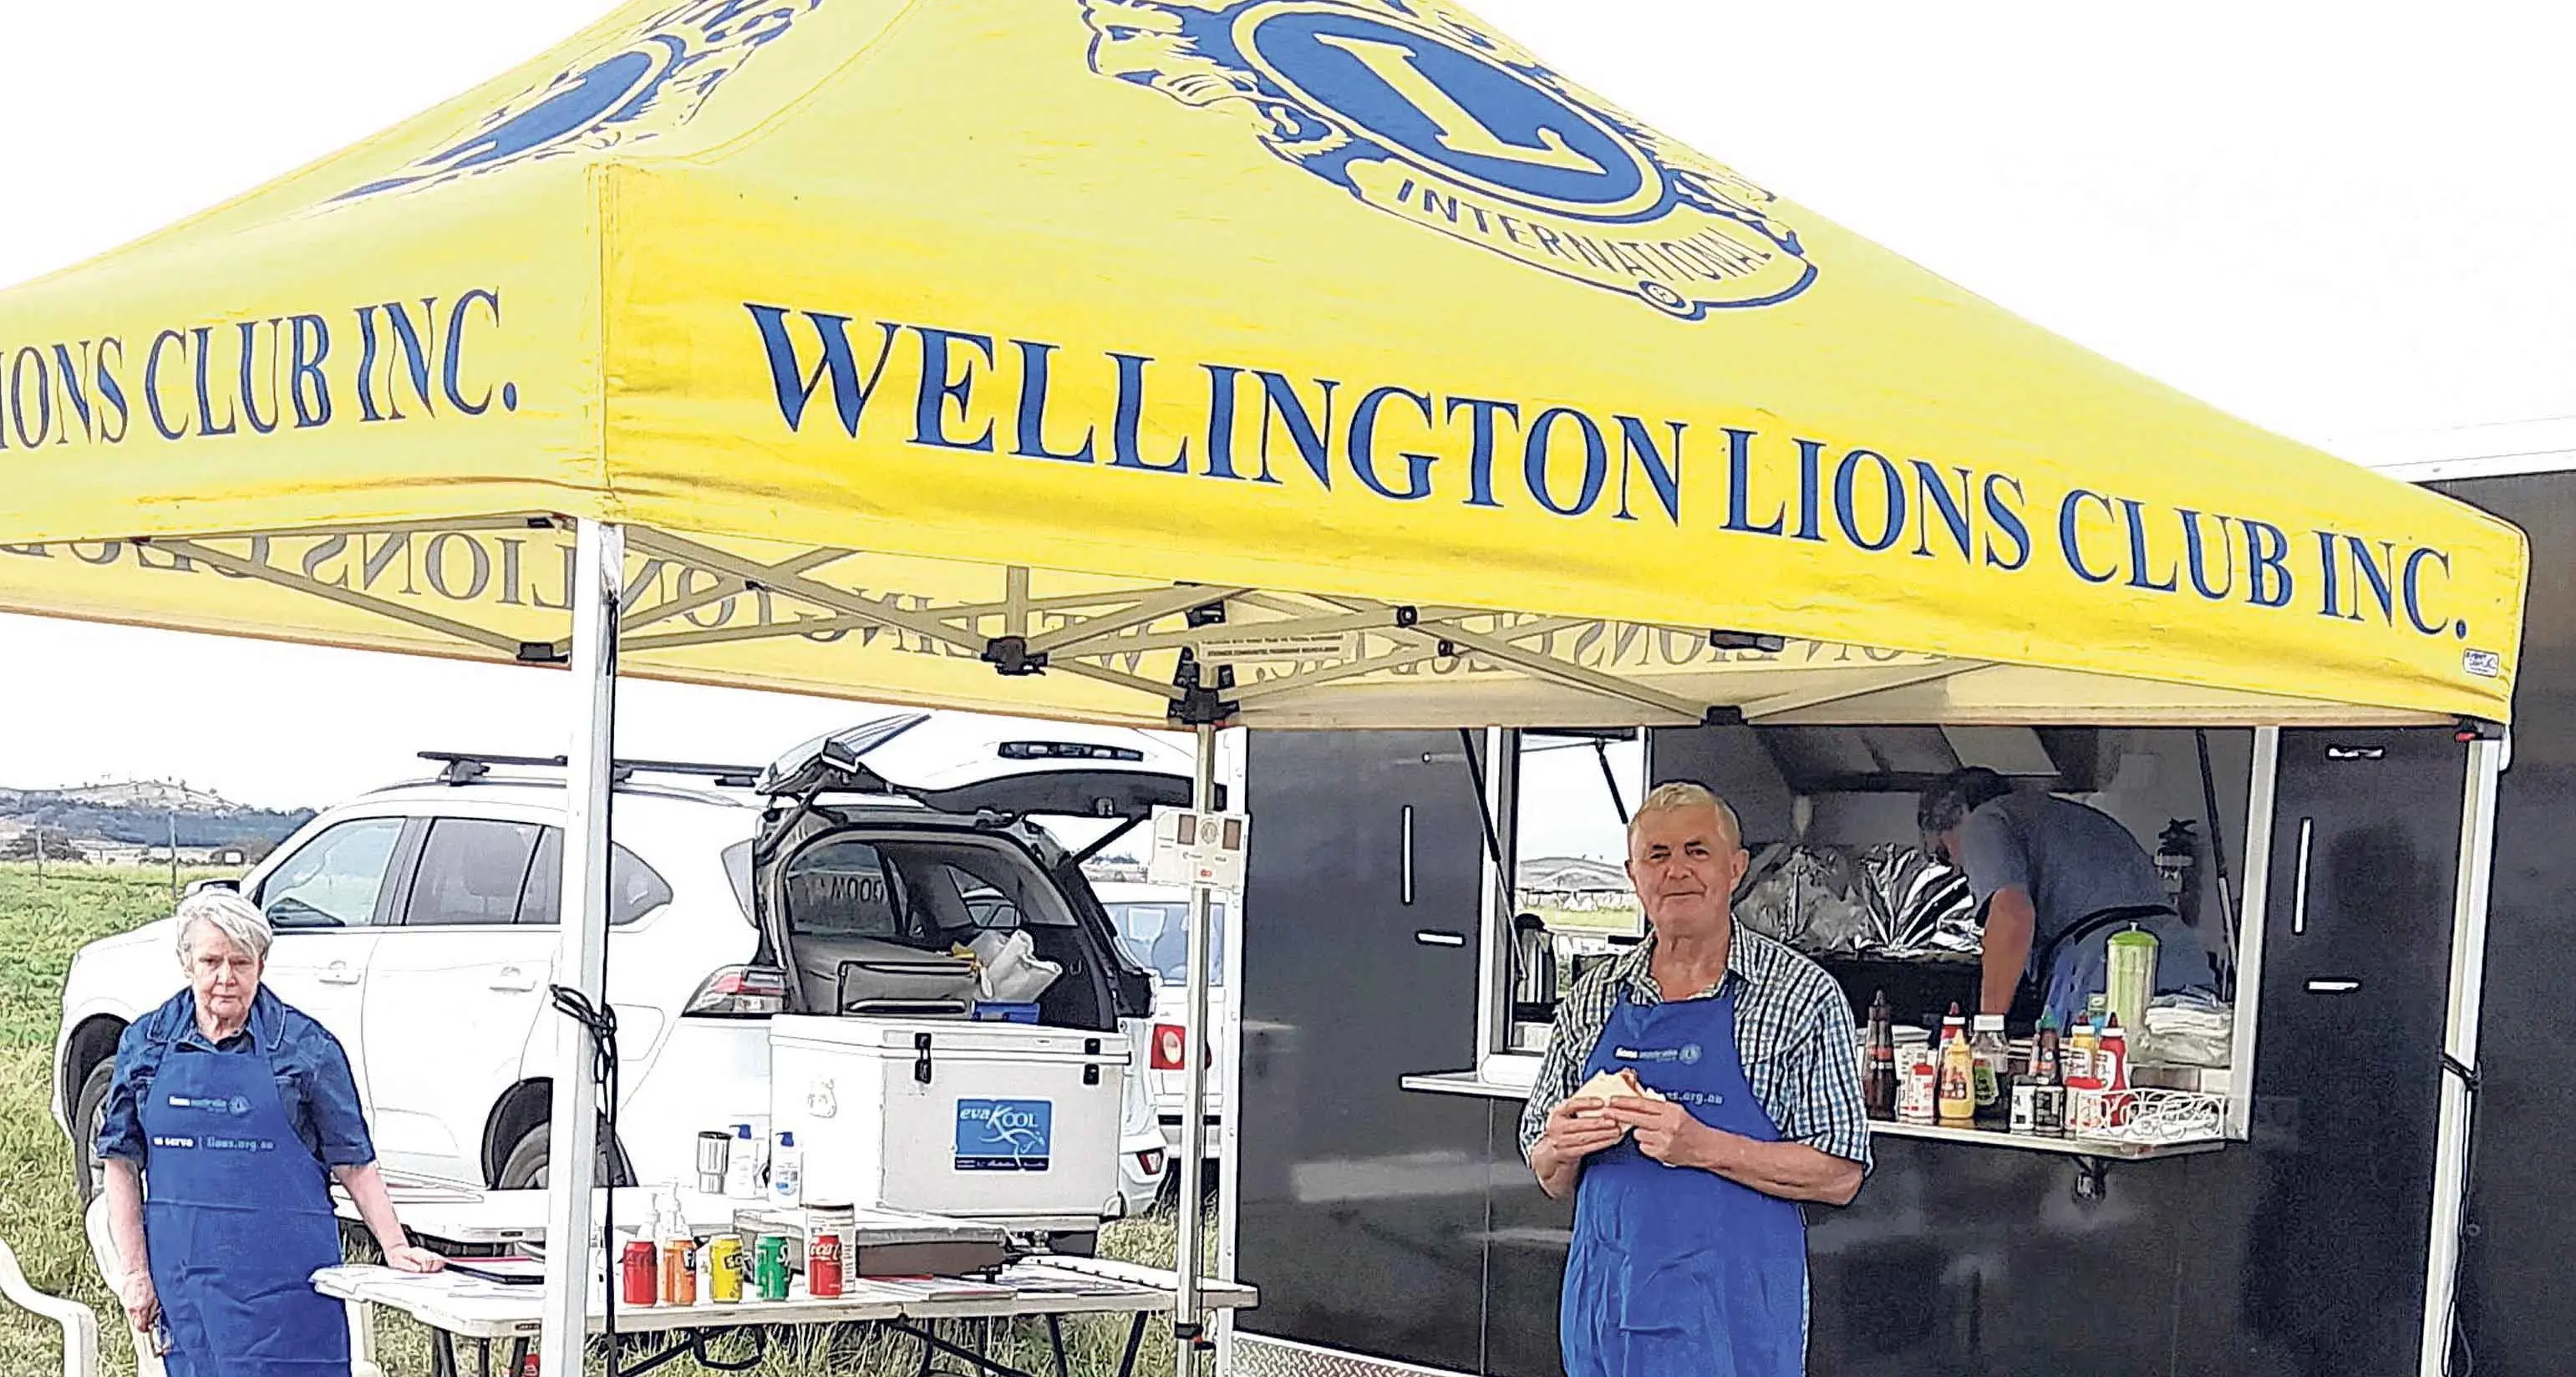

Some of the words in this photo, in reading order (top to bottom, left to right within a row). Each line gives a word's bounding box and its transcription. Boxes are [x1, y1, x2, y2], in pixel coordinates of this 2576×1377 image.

[1396, 178, 1772, 281] INTERNATIONAL
[145, 312, 332, 441] CLUB
[353, 286, 517, 423] INC.
[743, 302, 1689, 526] WELLINGTON
[1719, 428, 2032, 572] LIONS
[2059, 489, 2294, 608] CLUB
[2313, 528, 2467, 640] INC.
